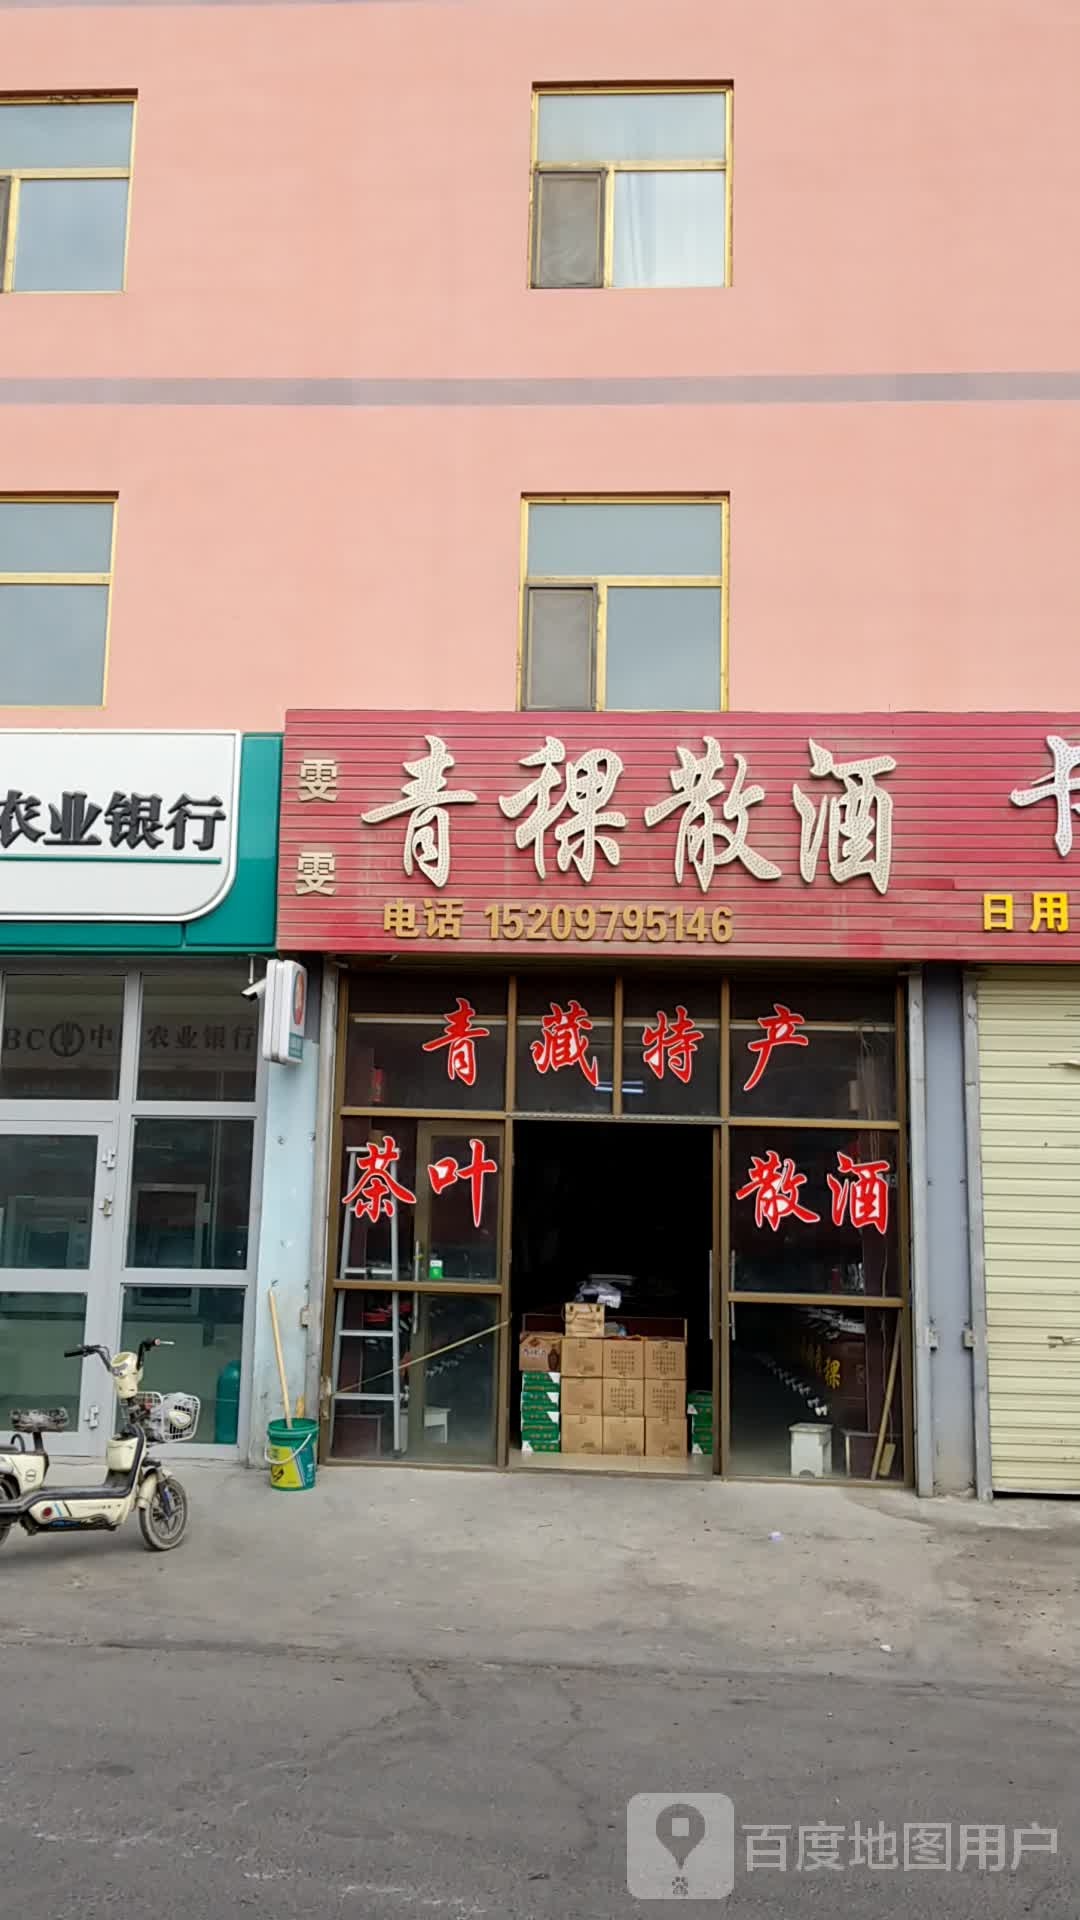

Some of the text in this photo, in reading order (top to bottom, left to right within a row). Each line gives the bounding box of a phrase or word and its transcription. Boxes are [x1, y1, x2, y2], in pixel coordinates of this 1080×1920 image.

[0, 789, 226, 851] 农业银行
[296, 758, 338, 896] 雯雯
[361, 735, 897, 894] 青稞散酒
[383, 898, 734, 943] 电话 15209795146
[983, 891, 1069, 932] 日用
[422, 998, 809, 1091] 青藏特产
[342, 1136, 497, 1228] 茶叶
[736, 1150, 889, 1236] 散酒
